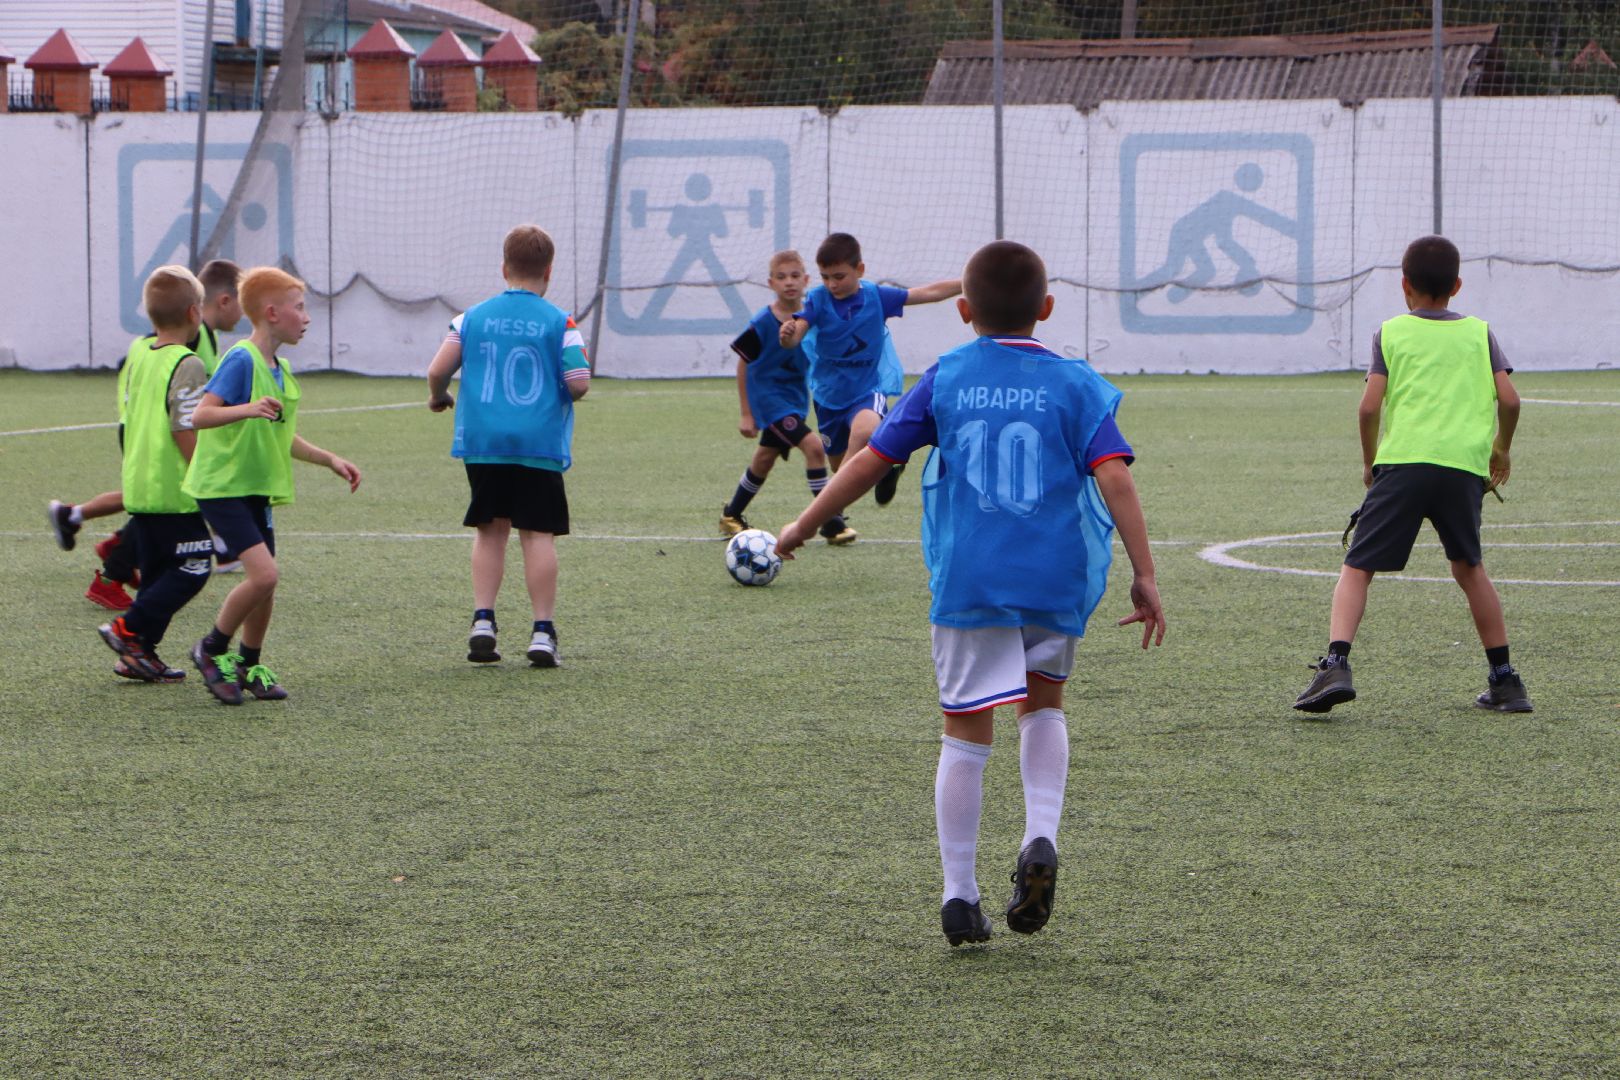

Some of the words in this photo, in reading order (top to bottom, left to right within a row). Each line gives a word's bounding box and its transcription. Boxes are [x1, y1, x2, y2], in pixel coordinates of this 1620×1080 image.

[484, 318, 546, 338] MESSI
[480, 341, 544, 406] 10
[957, 386, 1048, 412] MBAPPÉ
[956, 419, 1044, 518] 10
[176, 540, 212, 554] NIKE
